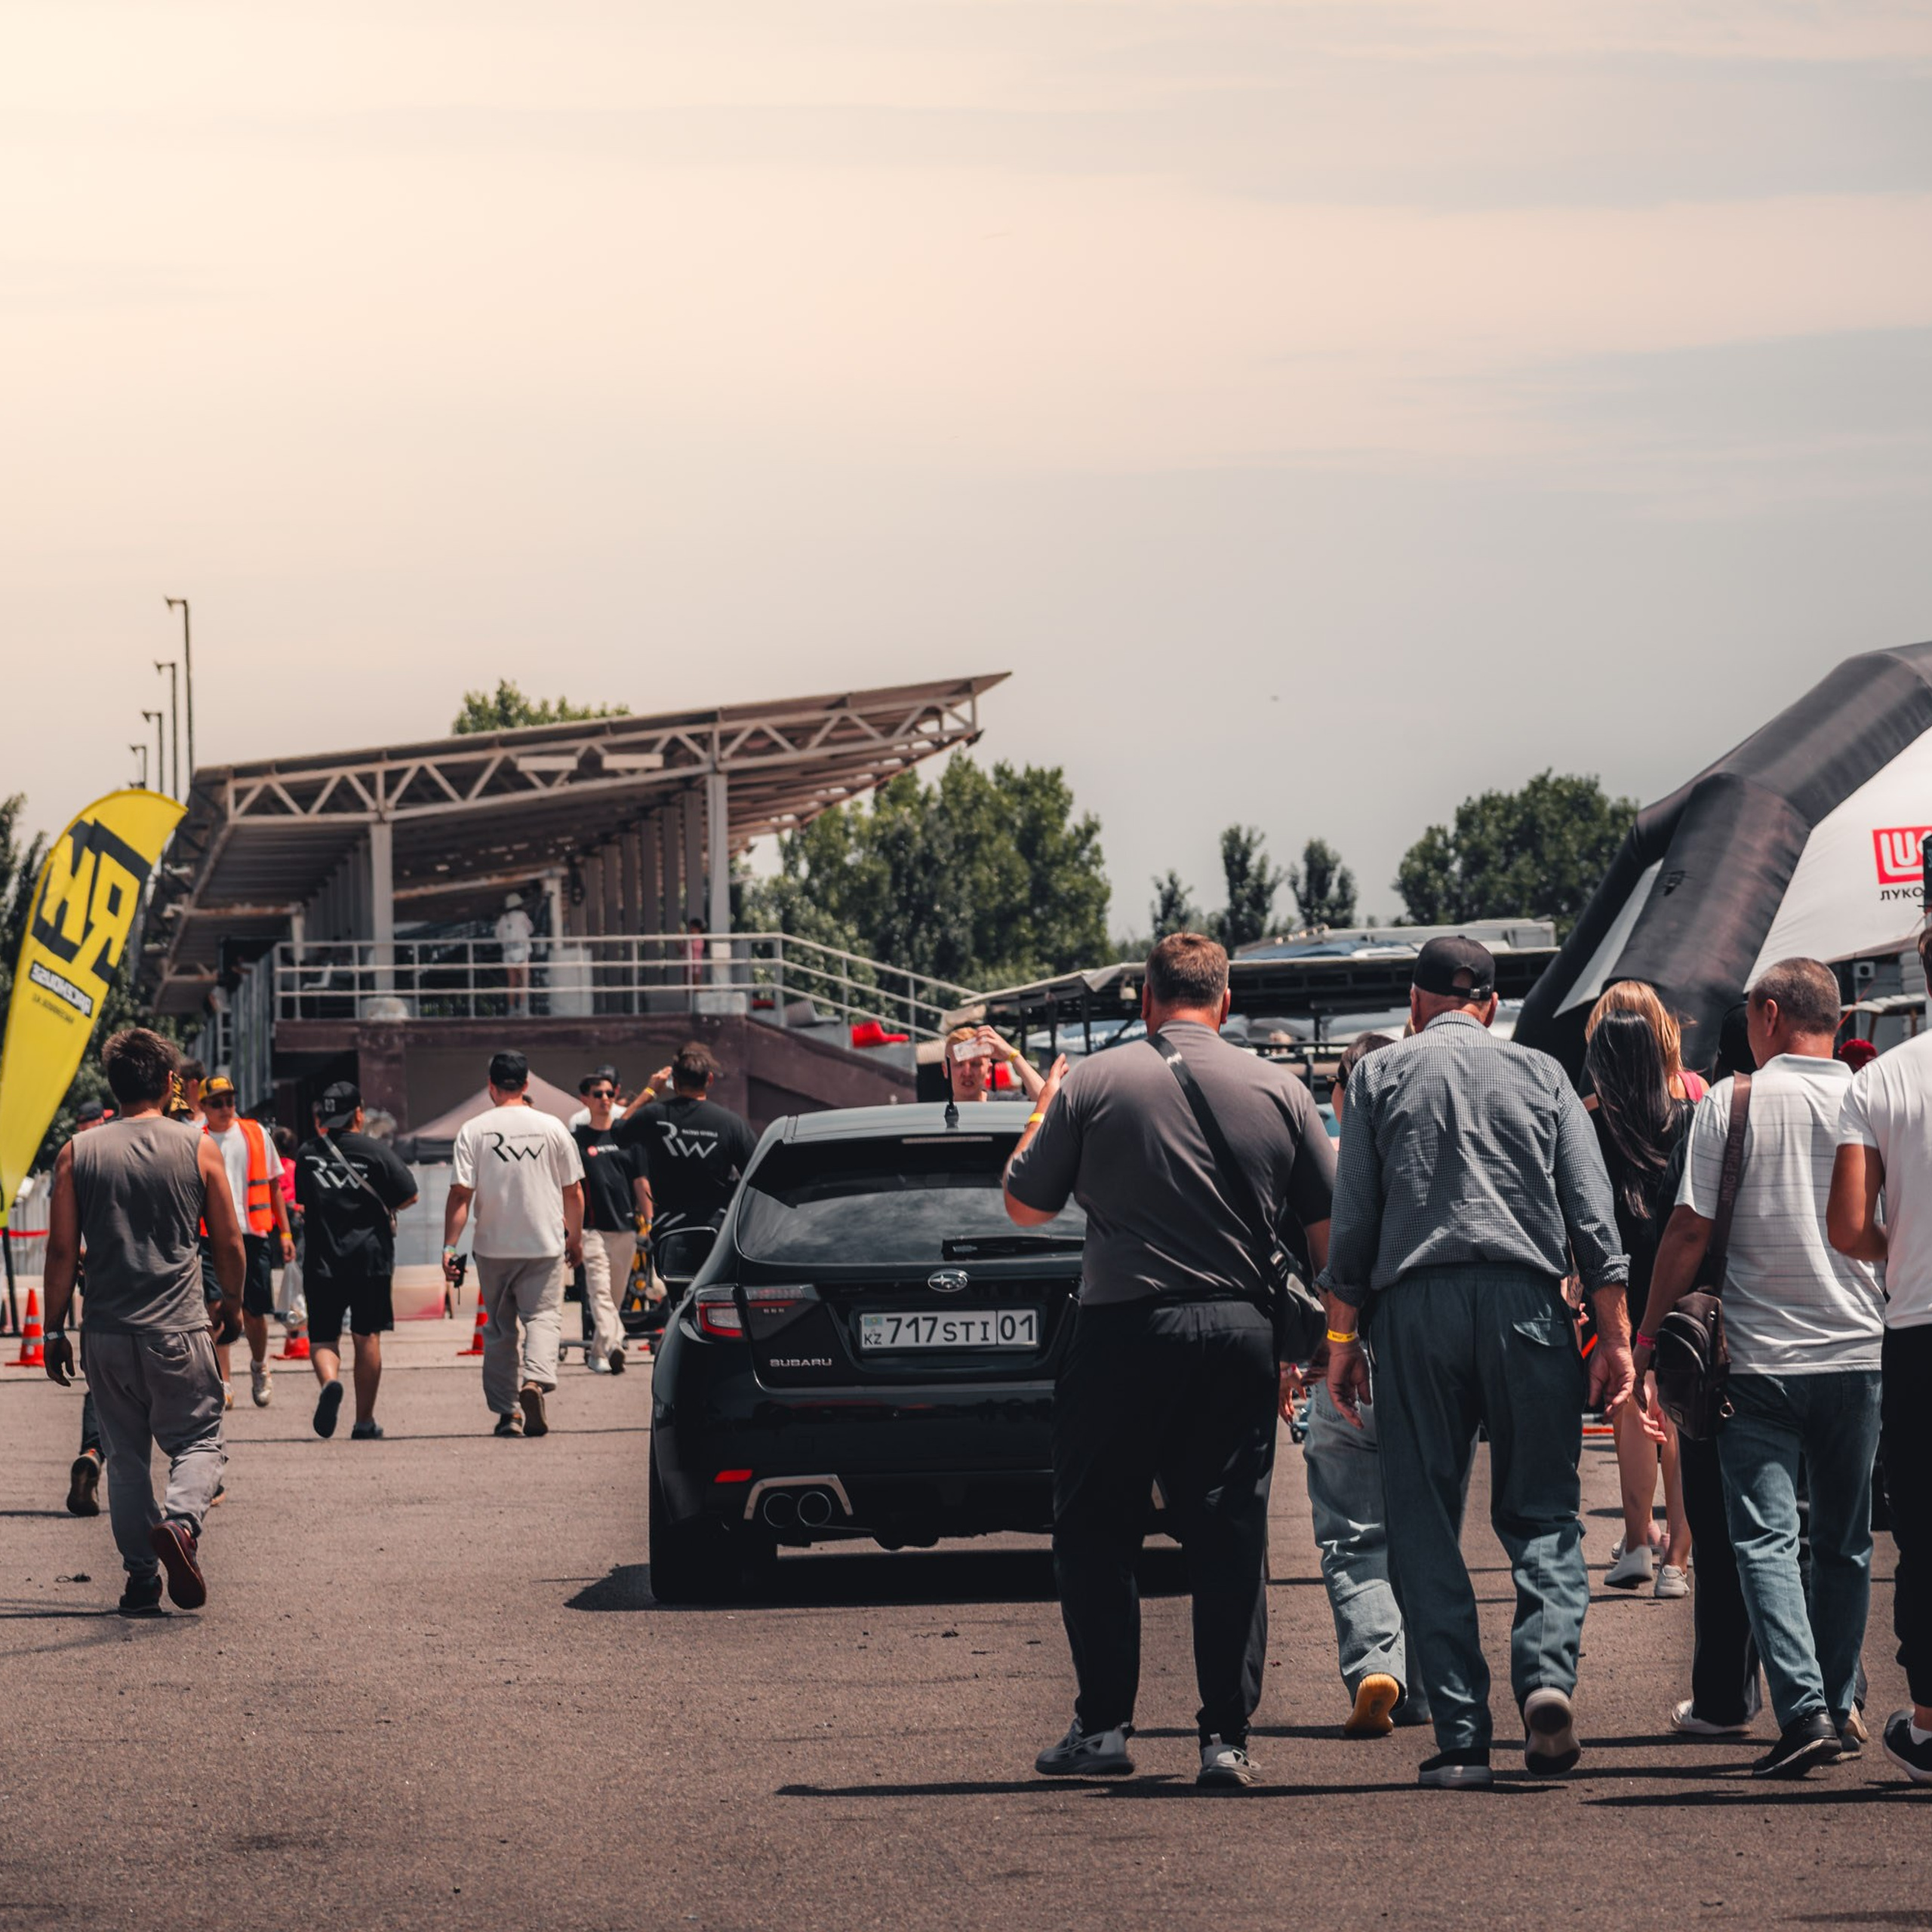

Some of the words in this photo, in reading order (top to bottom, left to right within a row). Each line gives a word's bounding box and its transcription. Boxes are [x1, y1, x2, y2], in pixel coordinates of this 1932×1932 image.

[1880, 887, 1925, 900] ЛУКО
[864, 1334, 882, 1345] KZ
[1000, 1314, 1033, 1342] 01
[769, 1358, 832, 1367] SUBARU
